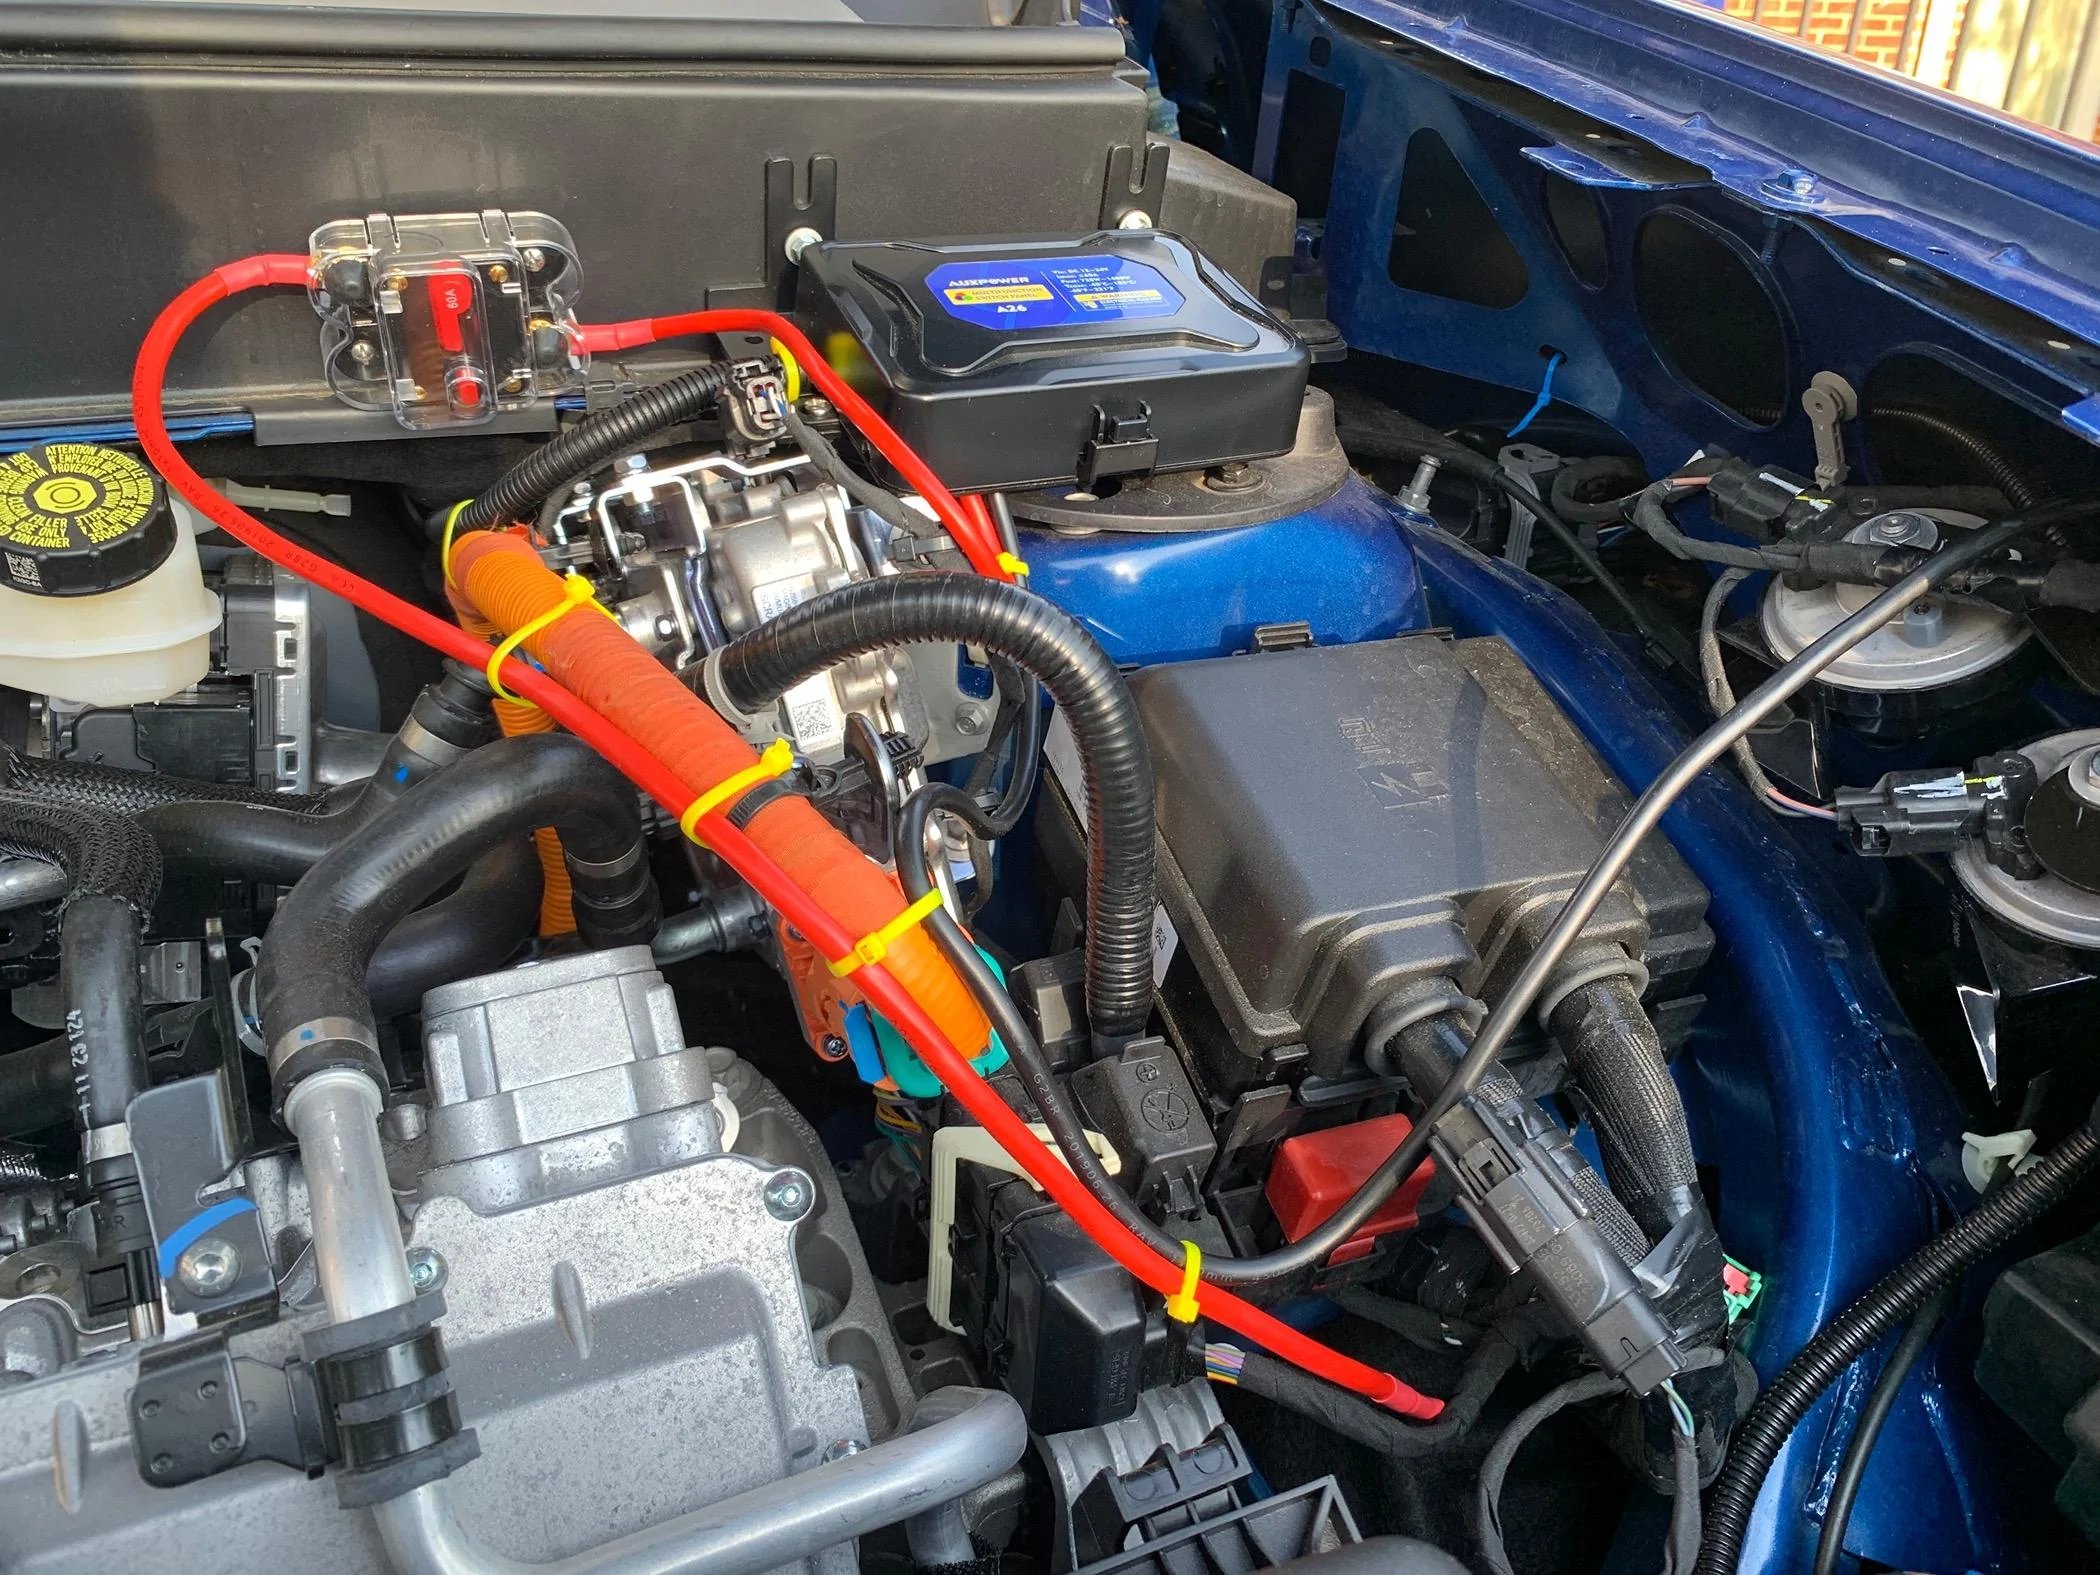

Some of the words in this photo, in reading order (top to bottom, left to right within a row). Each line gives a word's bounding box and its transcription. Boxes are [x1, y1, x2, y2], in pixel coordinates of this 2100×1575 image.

[949, 276, 1029, 287] AUXPOWER
[446, 289, 458, 309] 60A
[997, 305, 1027, 313] A26
[46, 444, 97, 455] ATTENTION
[8, 452, 30, 466] DOT
[20, 460, 39, 472] CAP
[60, 454, 104, 467] EMPLOYER
[98, 448, 140, 472] NETTOYER
[51, 463, 107, 478] PROVENANT
[100, 461, 121, 473] QUE
[131, 468, 148, 478] LE
[8, 468, 49, 494] WARNING
[8, 496, 33, 518] CLEAN
[28, 514, 68, 528] FILLER
[74, 507, 109, 527] SCELLE
[104, 507, 131, 525] FREIN
[122, 505, 149, 527] AVANT
[15, 521, 39, 535] USE
[38, 527, 67, 538] ONLY
[88, 522, 128, 544] DEPOSE
[89, 519, 109, 533] DOT
[9, 532, 70, 547] CONTAINER
[70, 1043, 88, 1068] 23
[1032, 1072, 1060, 1116] G2BR
[1127, 1220, 1157, 1249] RAV
